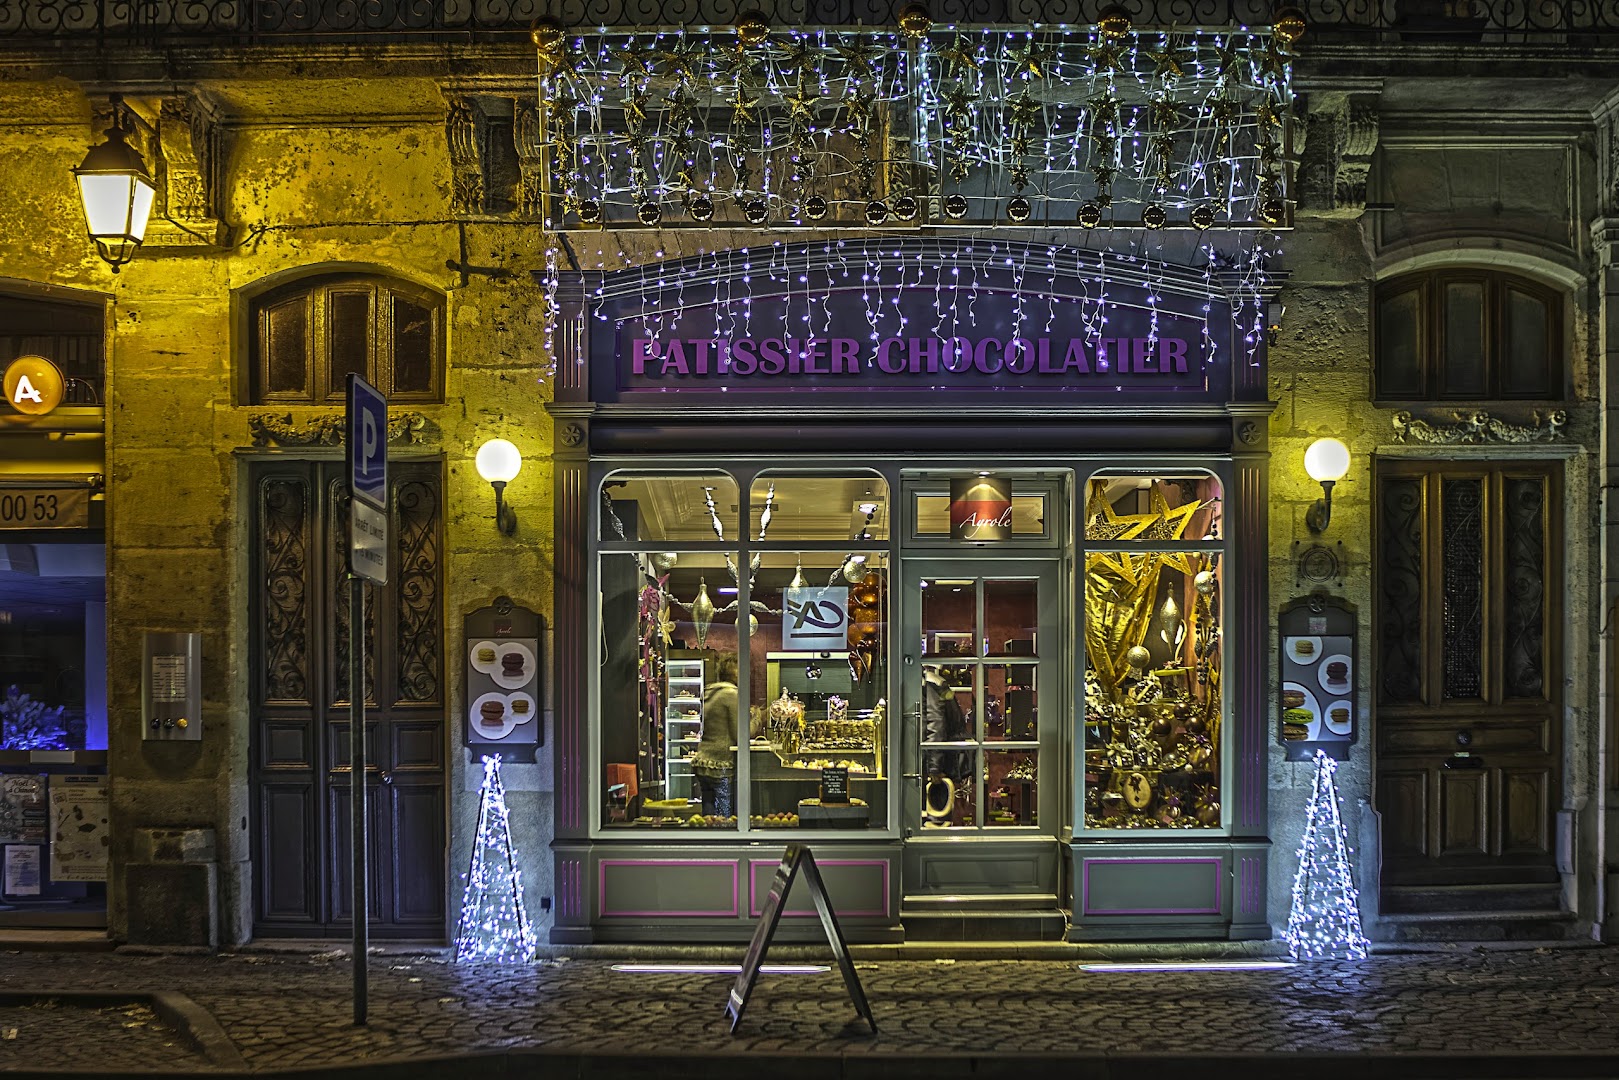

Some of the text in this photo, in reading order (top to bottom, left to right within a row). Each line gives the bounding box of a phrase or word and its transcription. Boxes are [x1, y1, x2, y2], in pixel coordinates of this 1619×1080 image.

[633, 337, 1188, 374] PATISSIER CHOCOLATIER
[363, 406, 377, 476] P
[2, 495, 58, 521] 00 53
